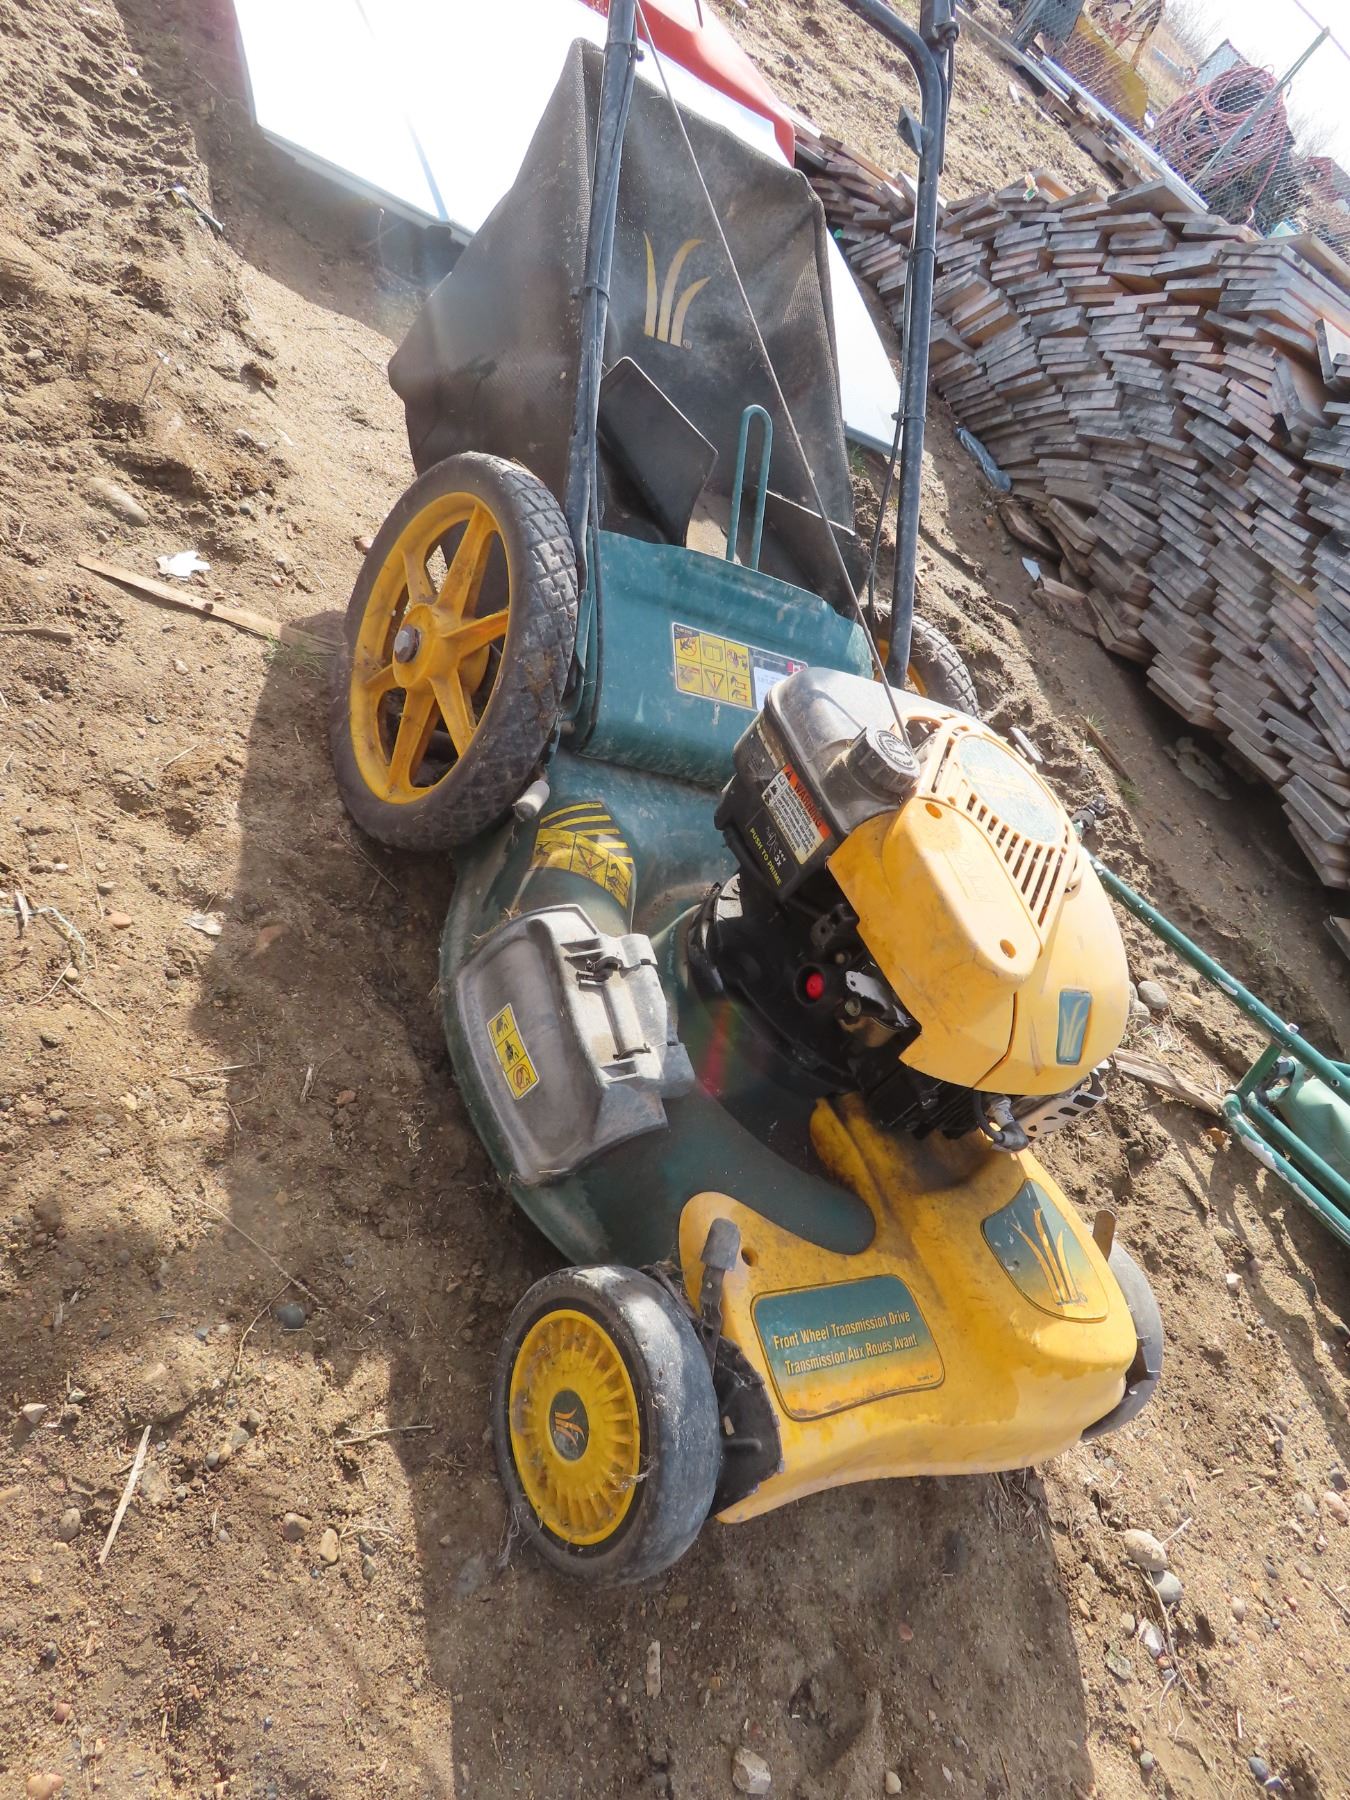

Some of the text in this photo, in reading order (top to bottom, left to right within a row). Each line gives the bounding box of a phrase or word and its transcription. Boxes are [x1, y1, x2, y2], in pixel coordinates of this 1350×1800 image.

[794, 781, 821, 827] WARNING
[749, 827, 782, 886] PUSH TO PRIME
[773, 1310, 911, 1350] Front Wheel Transmission Drive
[784, 1333, 918, 1376] Transmission Aux Roues Avant
